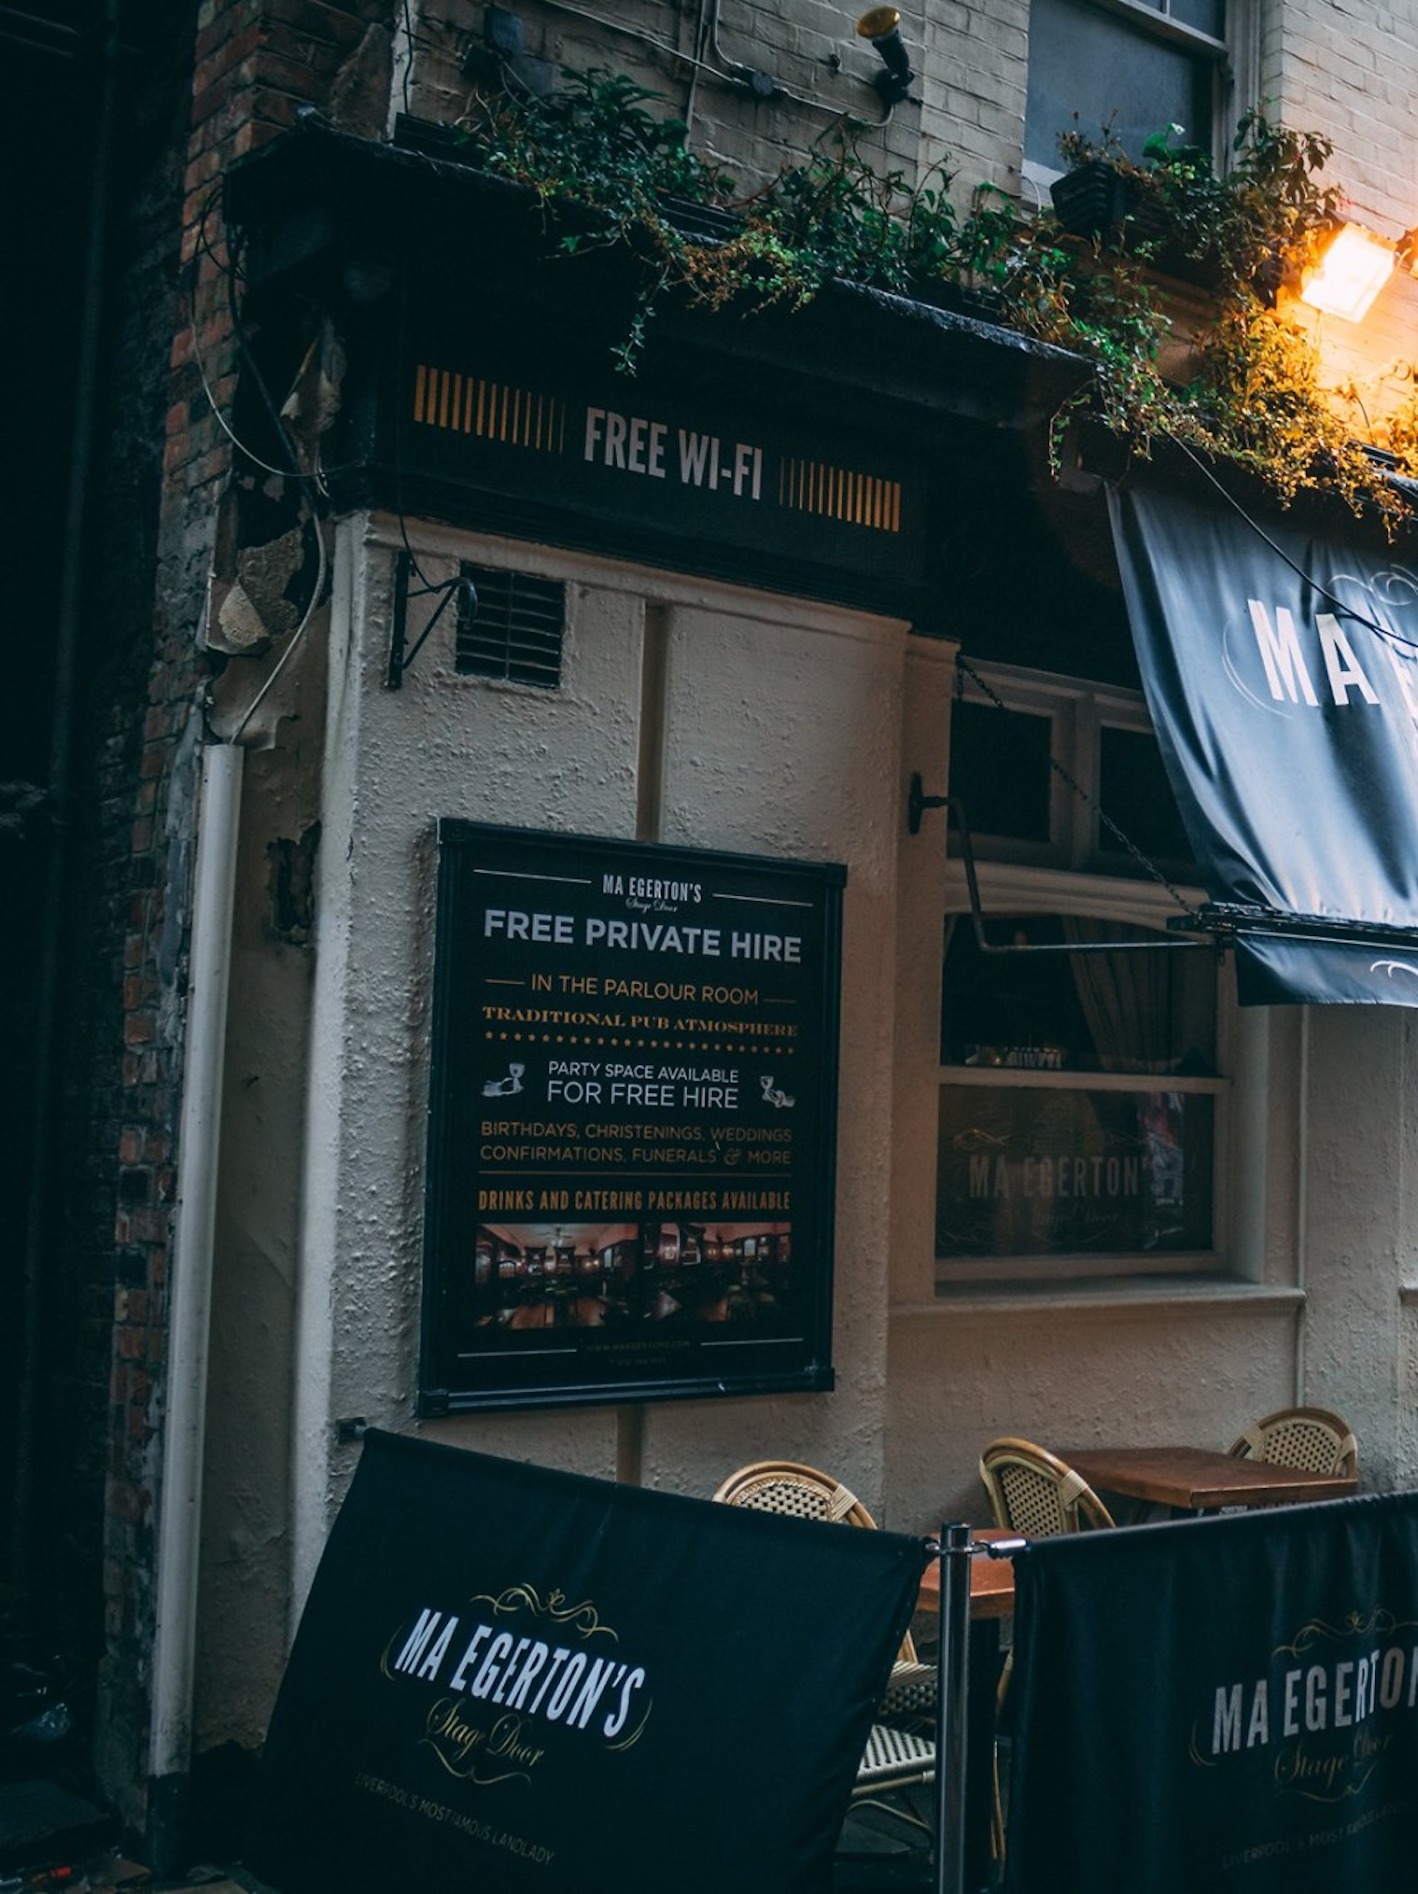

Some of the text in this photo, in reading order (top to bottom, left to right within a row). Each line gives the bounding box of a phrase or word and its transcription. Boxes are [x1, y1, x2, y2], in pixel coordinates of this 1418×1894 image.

[584, 406, 763, 500] FREE WI-FI
[1247, 599, 1380, 707] MA
[603, 874, 702, 904] MA EGERTON'S
[483, 908, 802, 964] FREE PRIVATE HIRE
[531, 973, 759, 1005] IN THE PARLOUR ROOM
[482, 1005, 798, 1037] TRADITIONAL PUB ATMOSPHERE
[548, 1060, 739, 1084] PARTY SPACE AVAILABLE
[547, 1080, 740, 1110] FOR FREE HIRE
[480, 1121, 793, 1143] BIRTHDAYS, CHRISTENINGS, WEDDINGS
[480, 1145, 792, 1167] CONFIRMATIONS, FUNERALS & MORE
[969, 1155, 1010, 1199] MA
[478, 1189, 791, 1211] DRINKS AND CATERING PACKAGES AVAILABLE
[394, 1607, 646, 1738] MA EGERTON'S
[425, 1696, 546, 1767] Stage Door
[1212, 1678, 1270, 1754] MA
[1273, 1740, 1350, 1790] Stage
[354, 1772, 420, 1811] LIVERPOOL'S
[418, 1797, 453, 1822] MOST
[491, 1832, 557, 1866] LANDLADY
[1308, 1827, 1344, 1849] MOST
